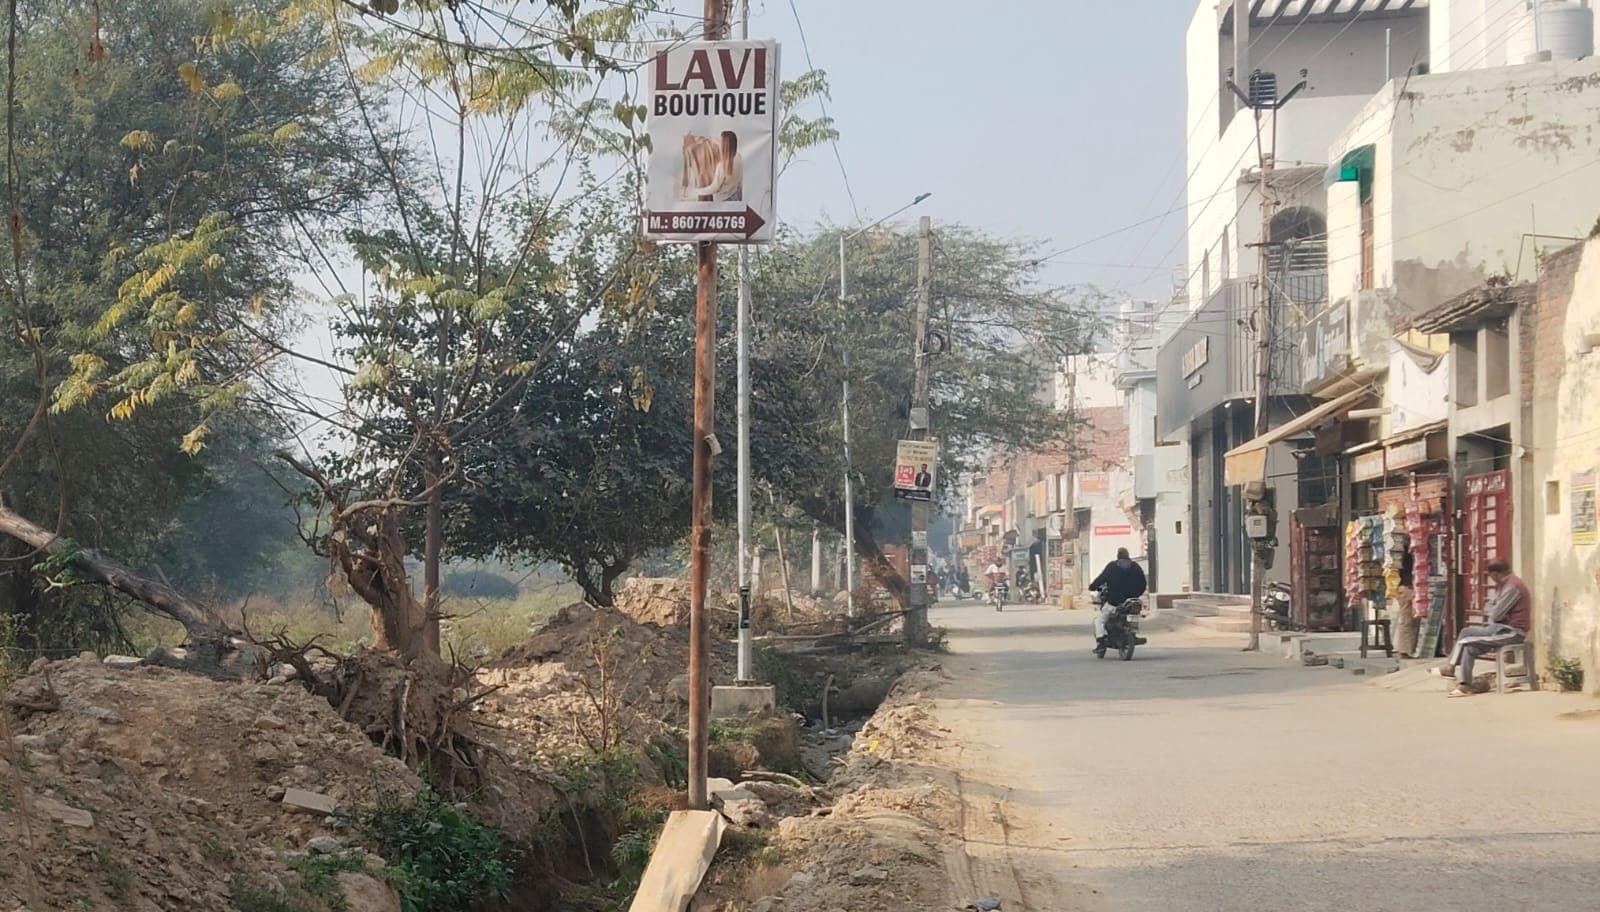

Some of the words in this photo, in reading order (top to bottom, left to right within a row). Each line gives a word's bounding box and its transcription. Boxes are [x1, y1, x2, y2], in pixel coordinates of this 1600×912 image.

[655, 48, 767, 91] LAVI
[654, 92, 767, 117] BOUTIQUE
[672, 216, 746, 229] 8607746769
